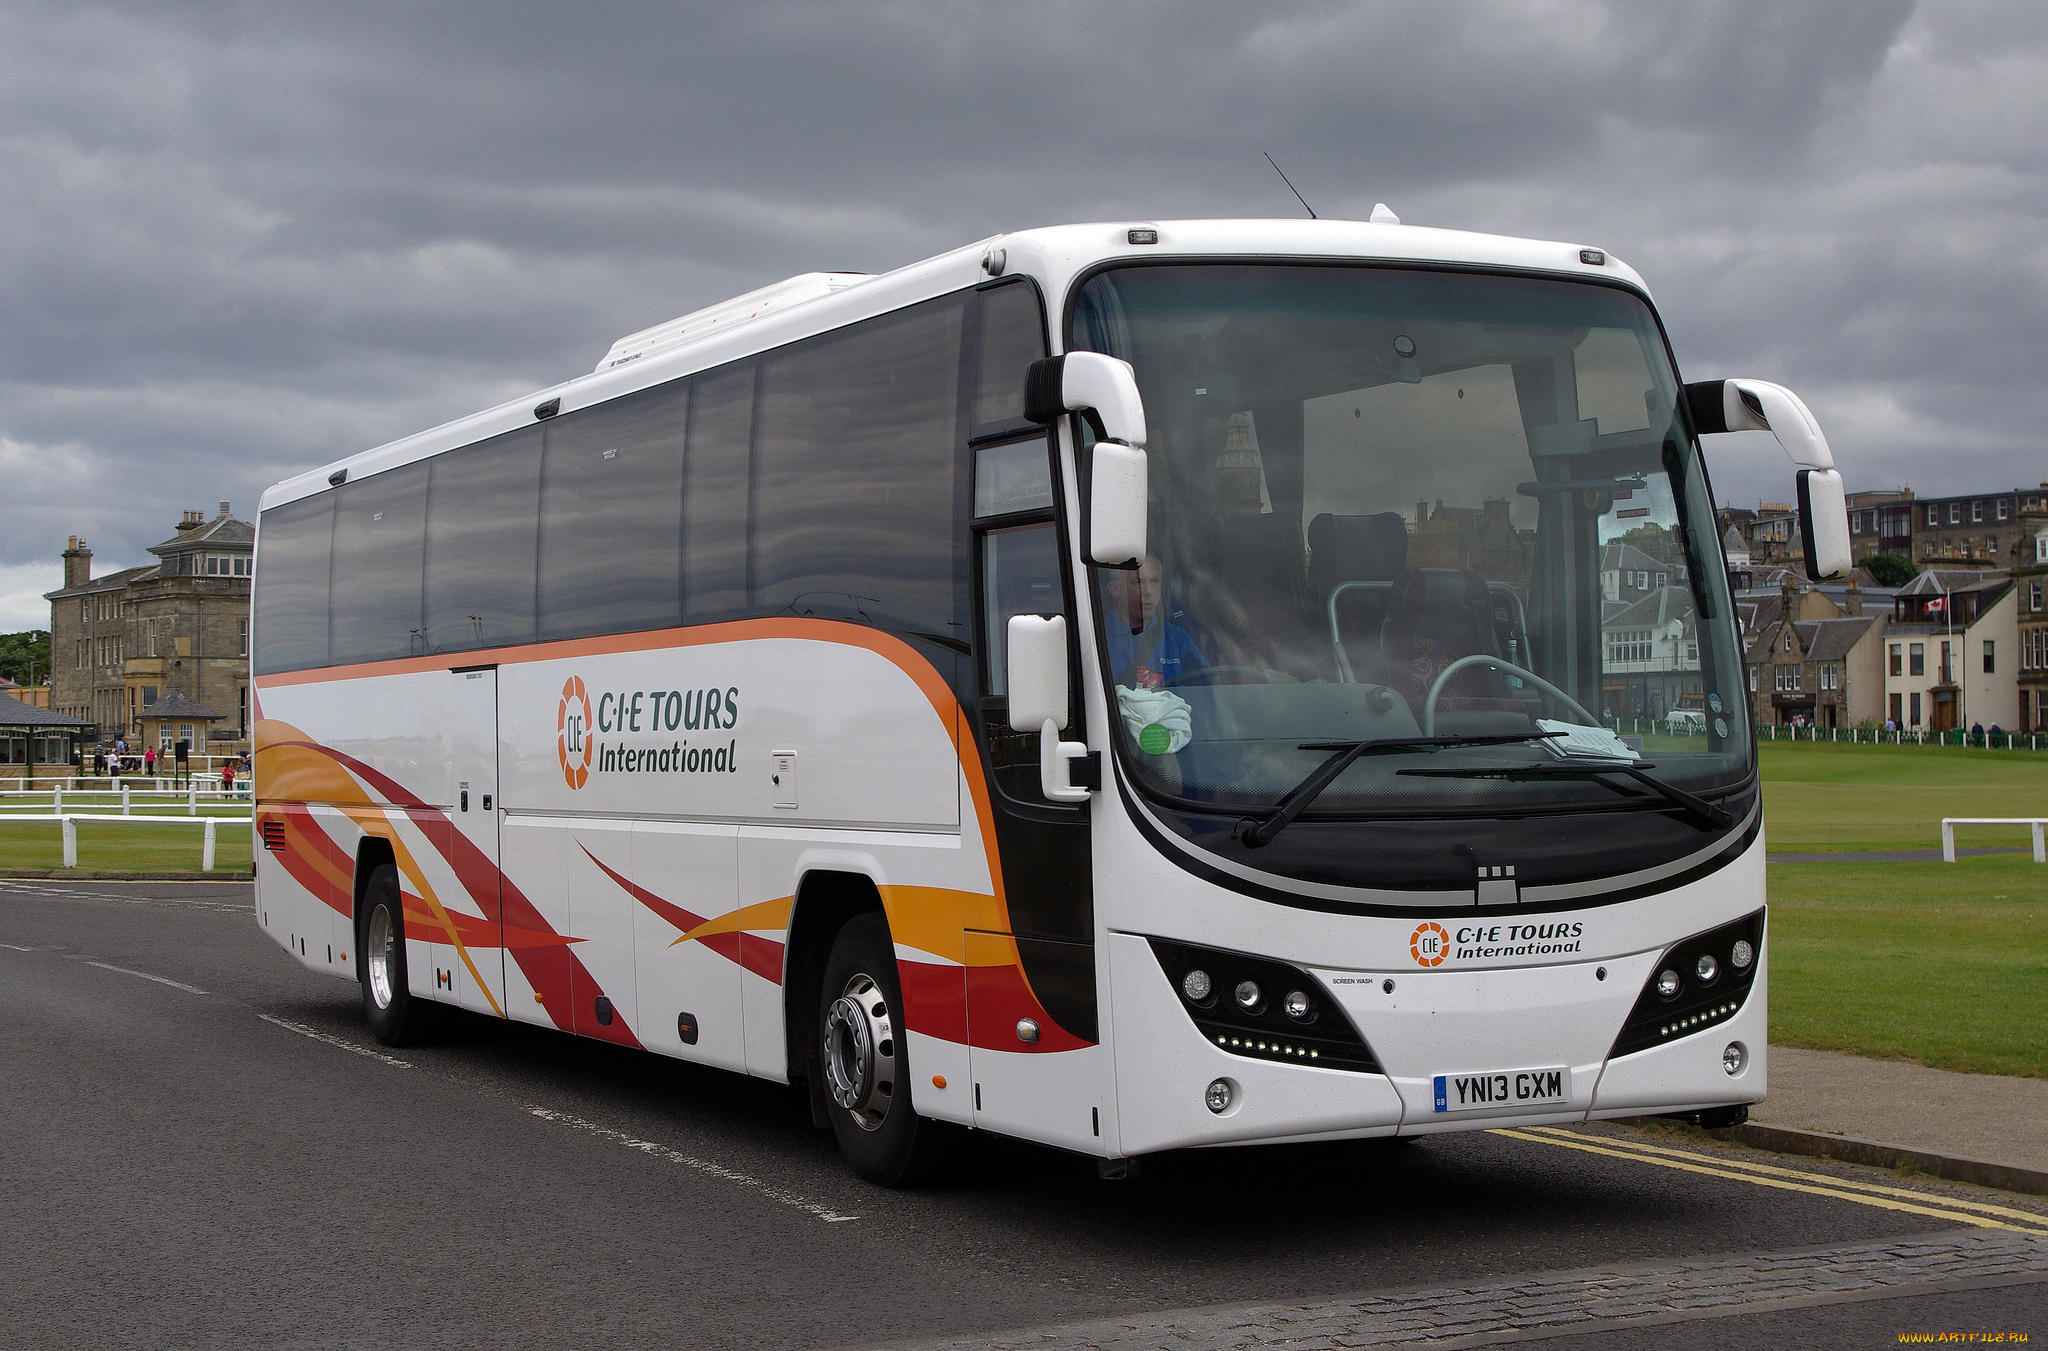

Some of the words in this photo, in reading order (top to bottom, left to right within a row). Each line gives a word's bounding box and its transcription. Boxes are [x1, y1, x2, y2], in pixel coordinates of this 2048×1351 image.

[649, 686, 739, 731] TOURS
[568, 715, 582, 753] CIE
[598, 738, 737, 774] International
[1508, 922, 1583, 941] TOURS
[1422, 937, 1439, 953] CIE
[1456, 940, 1582, 959] International
[1455, 1075, 1508, 1104] YN13
[1516, 1071, 1562, 1099] GXM
[1436, 1098, 1446, 1106] GB
